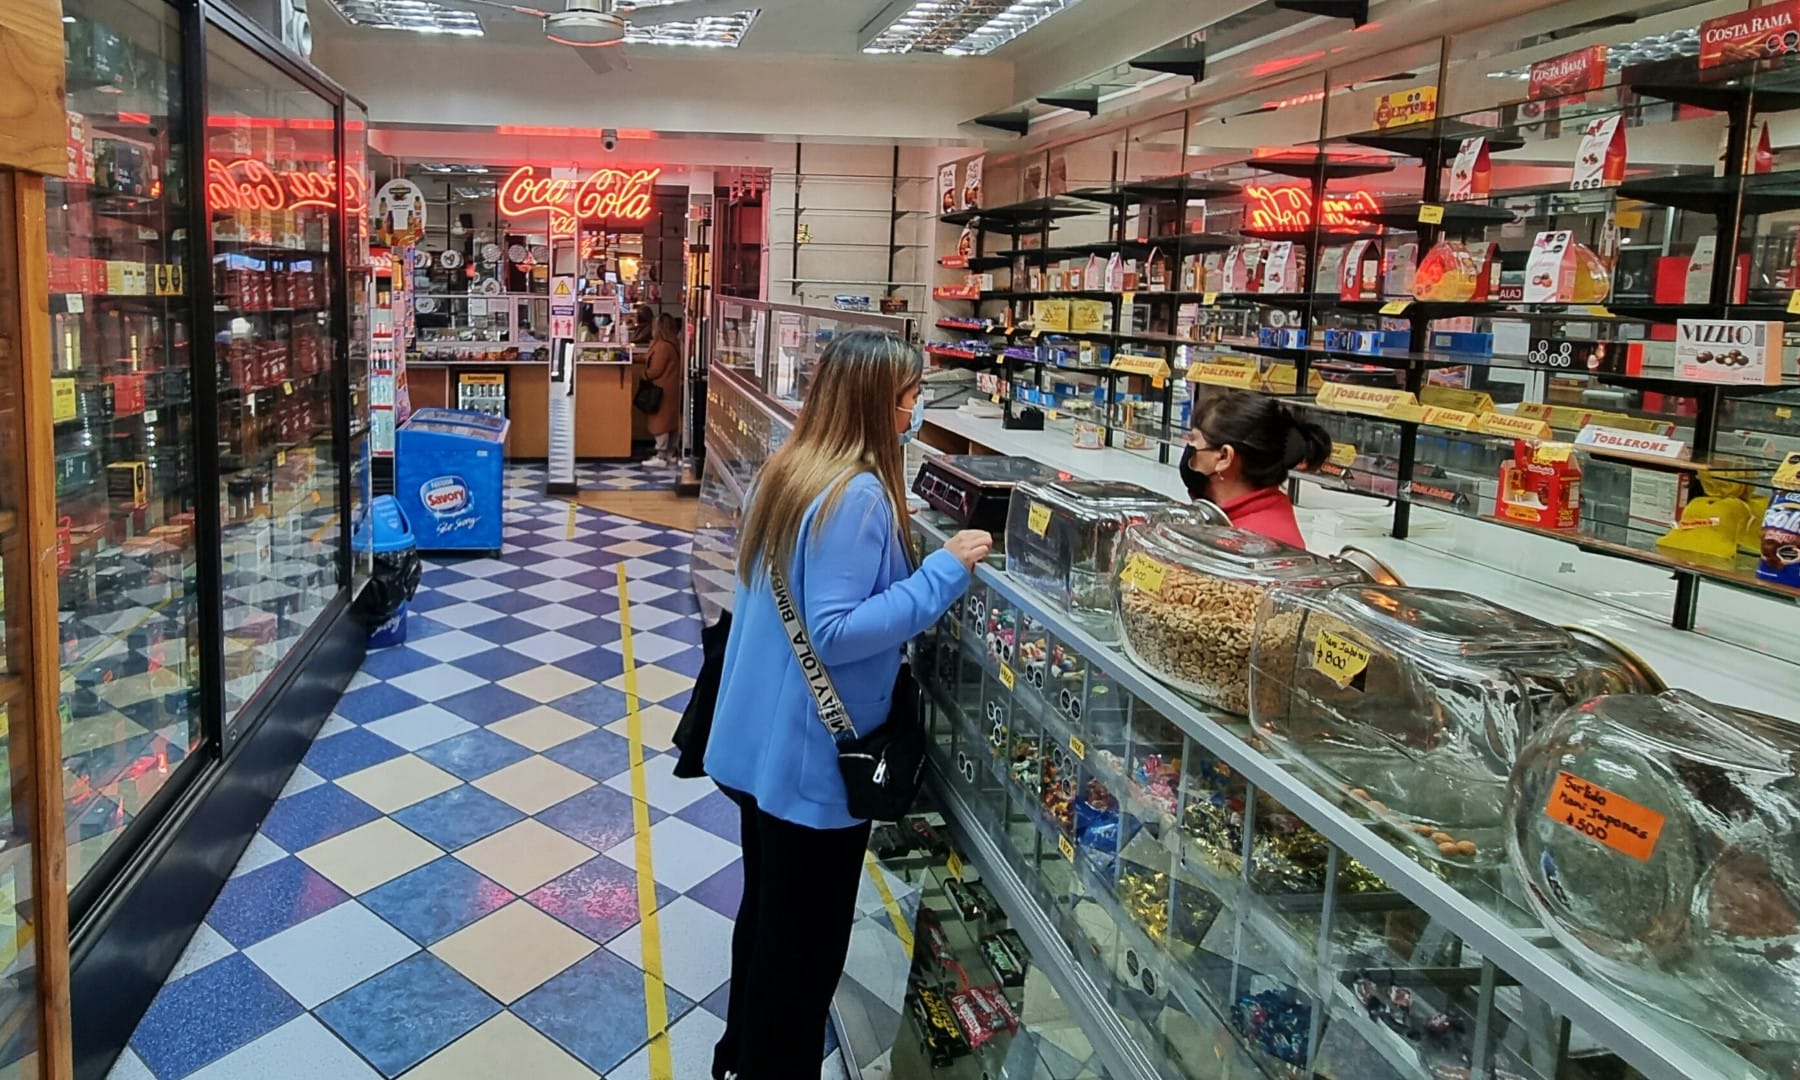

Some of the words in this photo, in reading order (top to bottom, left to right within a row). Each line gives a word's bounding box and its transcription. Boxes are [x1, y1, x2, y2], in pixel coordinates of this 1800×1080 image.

[1706, 23, 1749, 44] COSTA
[1751, 11, 1793, 33] RAMA
[1532, 65, 1559, 82] COSTA
[1560, 56, 1588, 75] RAMA
[574, 168, 661, 219] Cola
[1682, 324, 1753, 345] VIZZIO
[1200, 365, 1247, 378] TOBLERONE
[1334, 386, 1400, 404] TOBLERONE
[1487, 414, 1536, 431] TOBLERONE
[1592, 432, 1669, 452] TOBLERONE
[427, 489, 464, 507] Savory
[792, 630, 823, 682] LOLA
